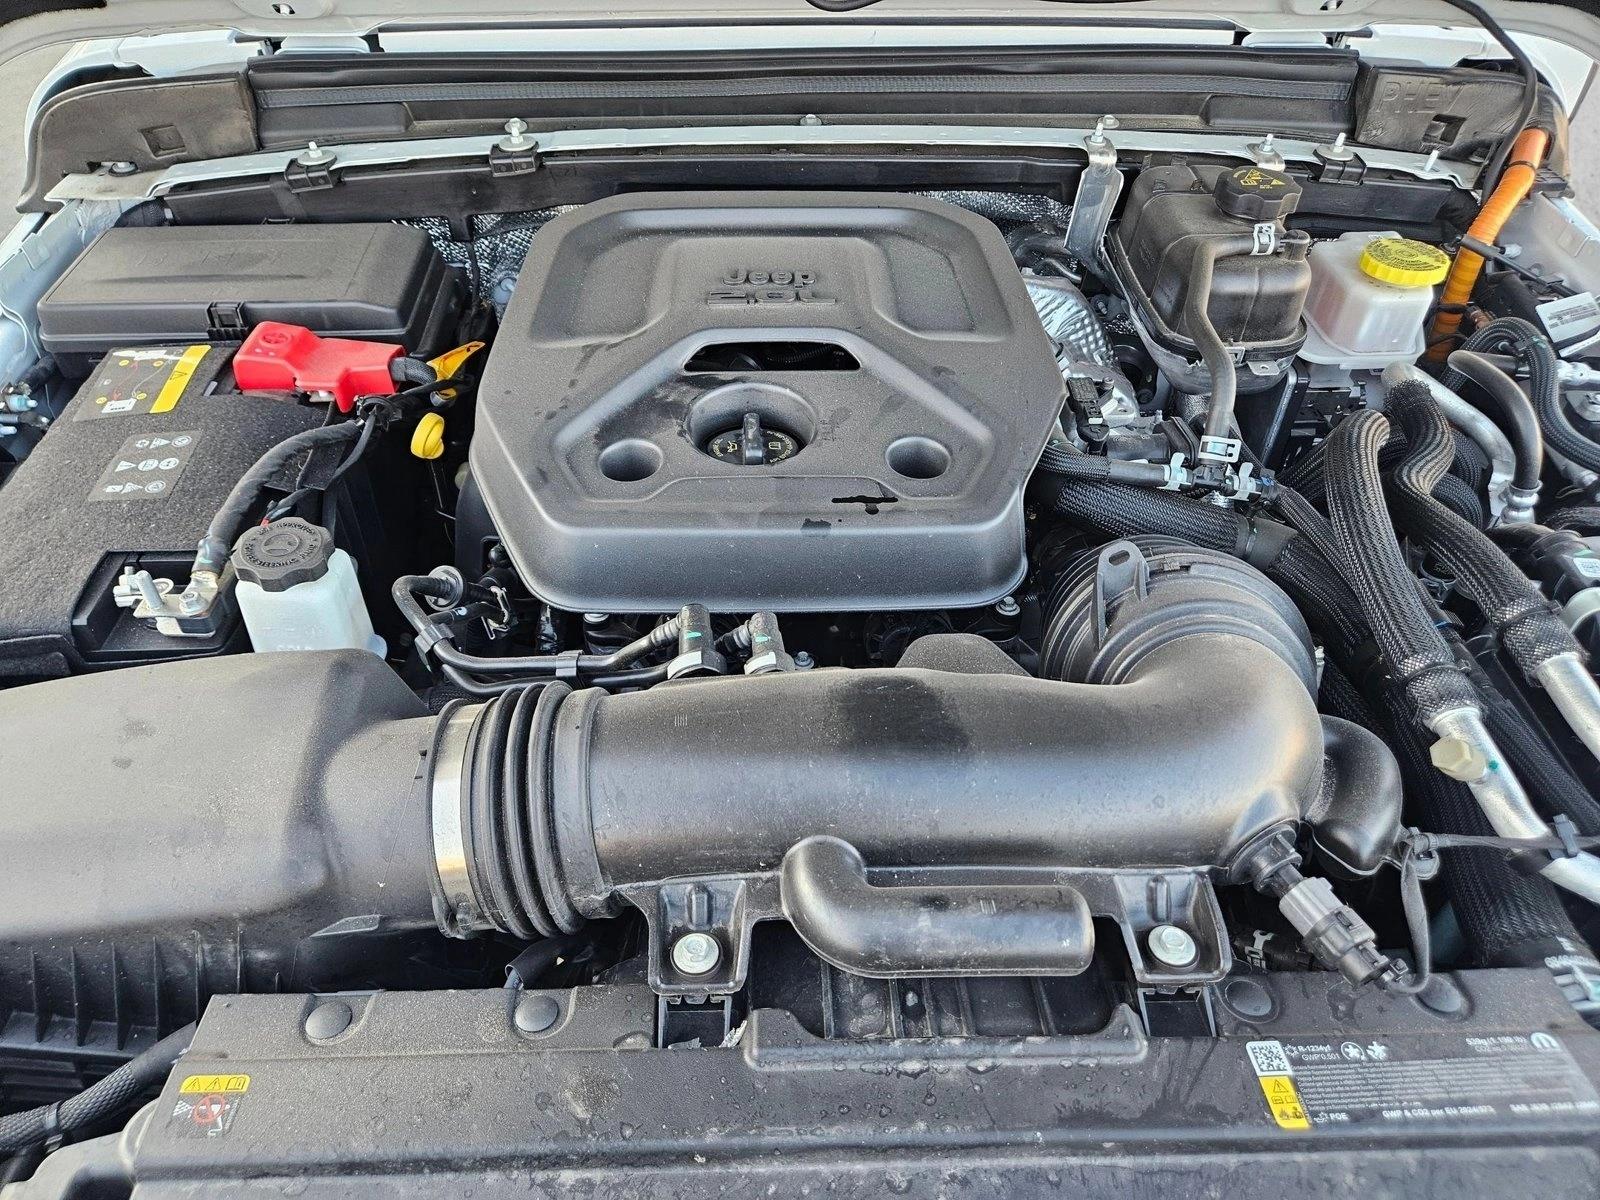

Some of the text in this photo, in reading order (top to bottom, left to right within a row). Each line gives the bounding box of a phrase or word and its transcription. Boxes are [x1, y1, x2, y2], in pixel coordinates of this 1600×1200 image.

[1377, 81, 1464, 113] PHEV
[722, 269, 818, 289] Jeep
[1382, 1110, 1403, 1119] GWP
[1445, 1107, 1458, 1115] EU
